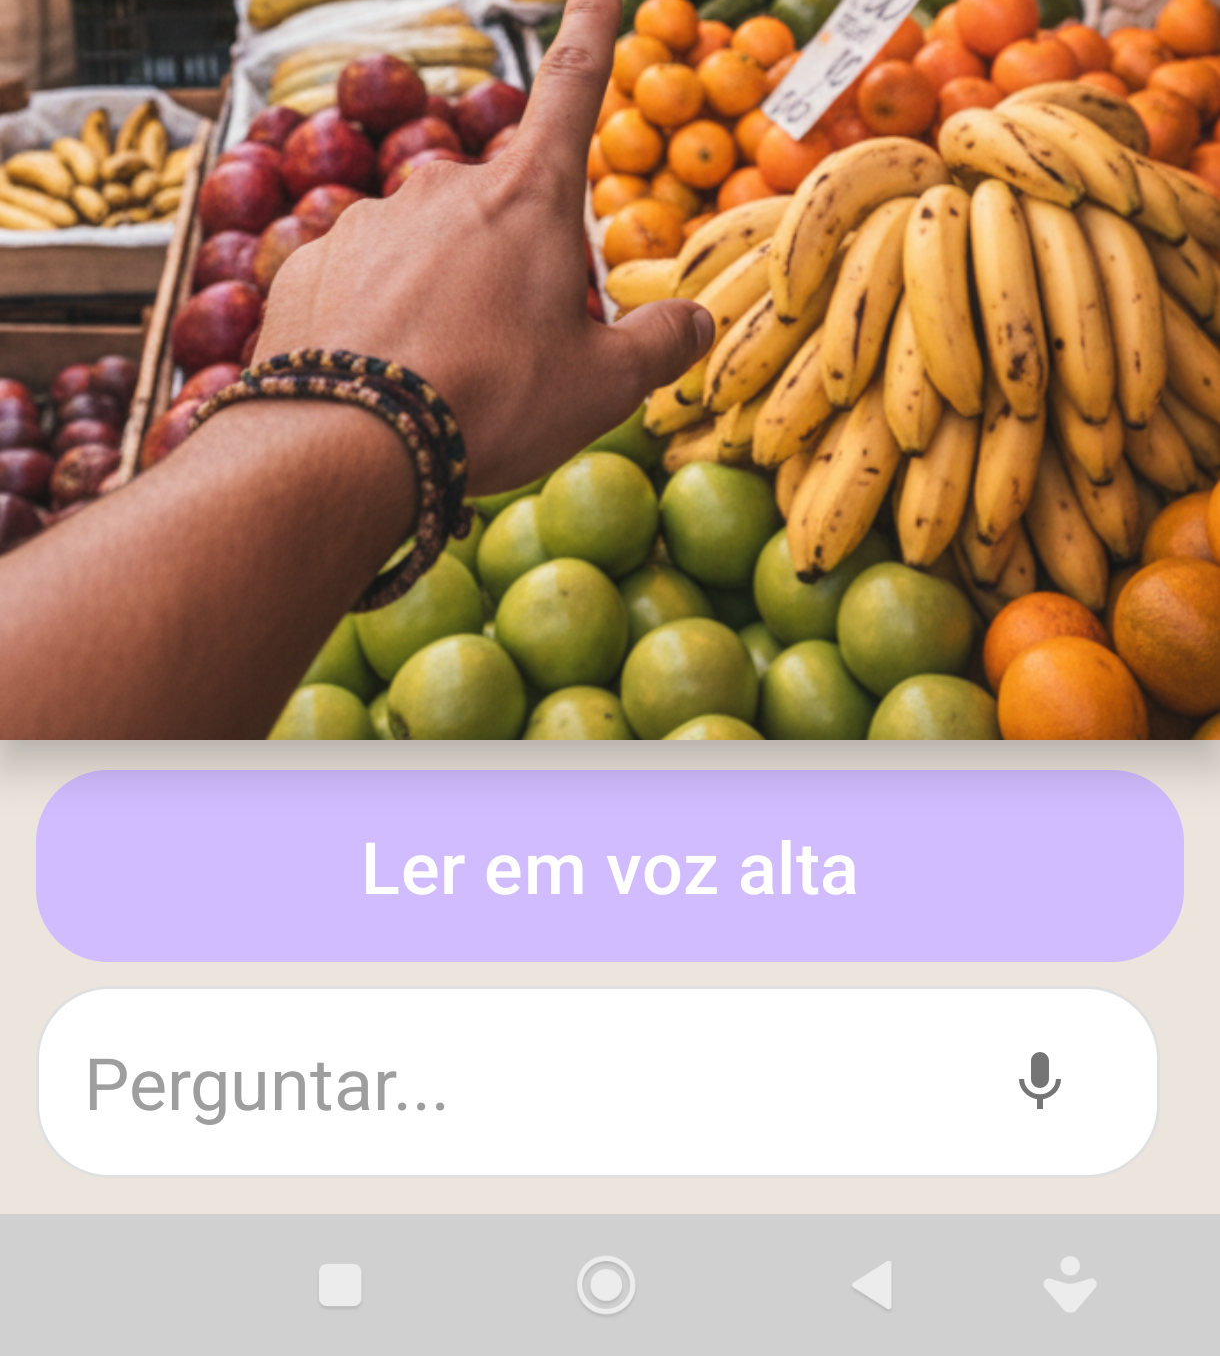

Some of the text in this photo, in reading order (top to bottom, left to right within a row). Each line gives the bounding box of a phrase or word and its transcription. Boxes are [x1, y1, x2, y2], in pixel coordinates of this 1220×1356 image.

[366, 840, 856, 895] Ler em voz alta
[88, 1058, 446, 1126] Perguntar...
